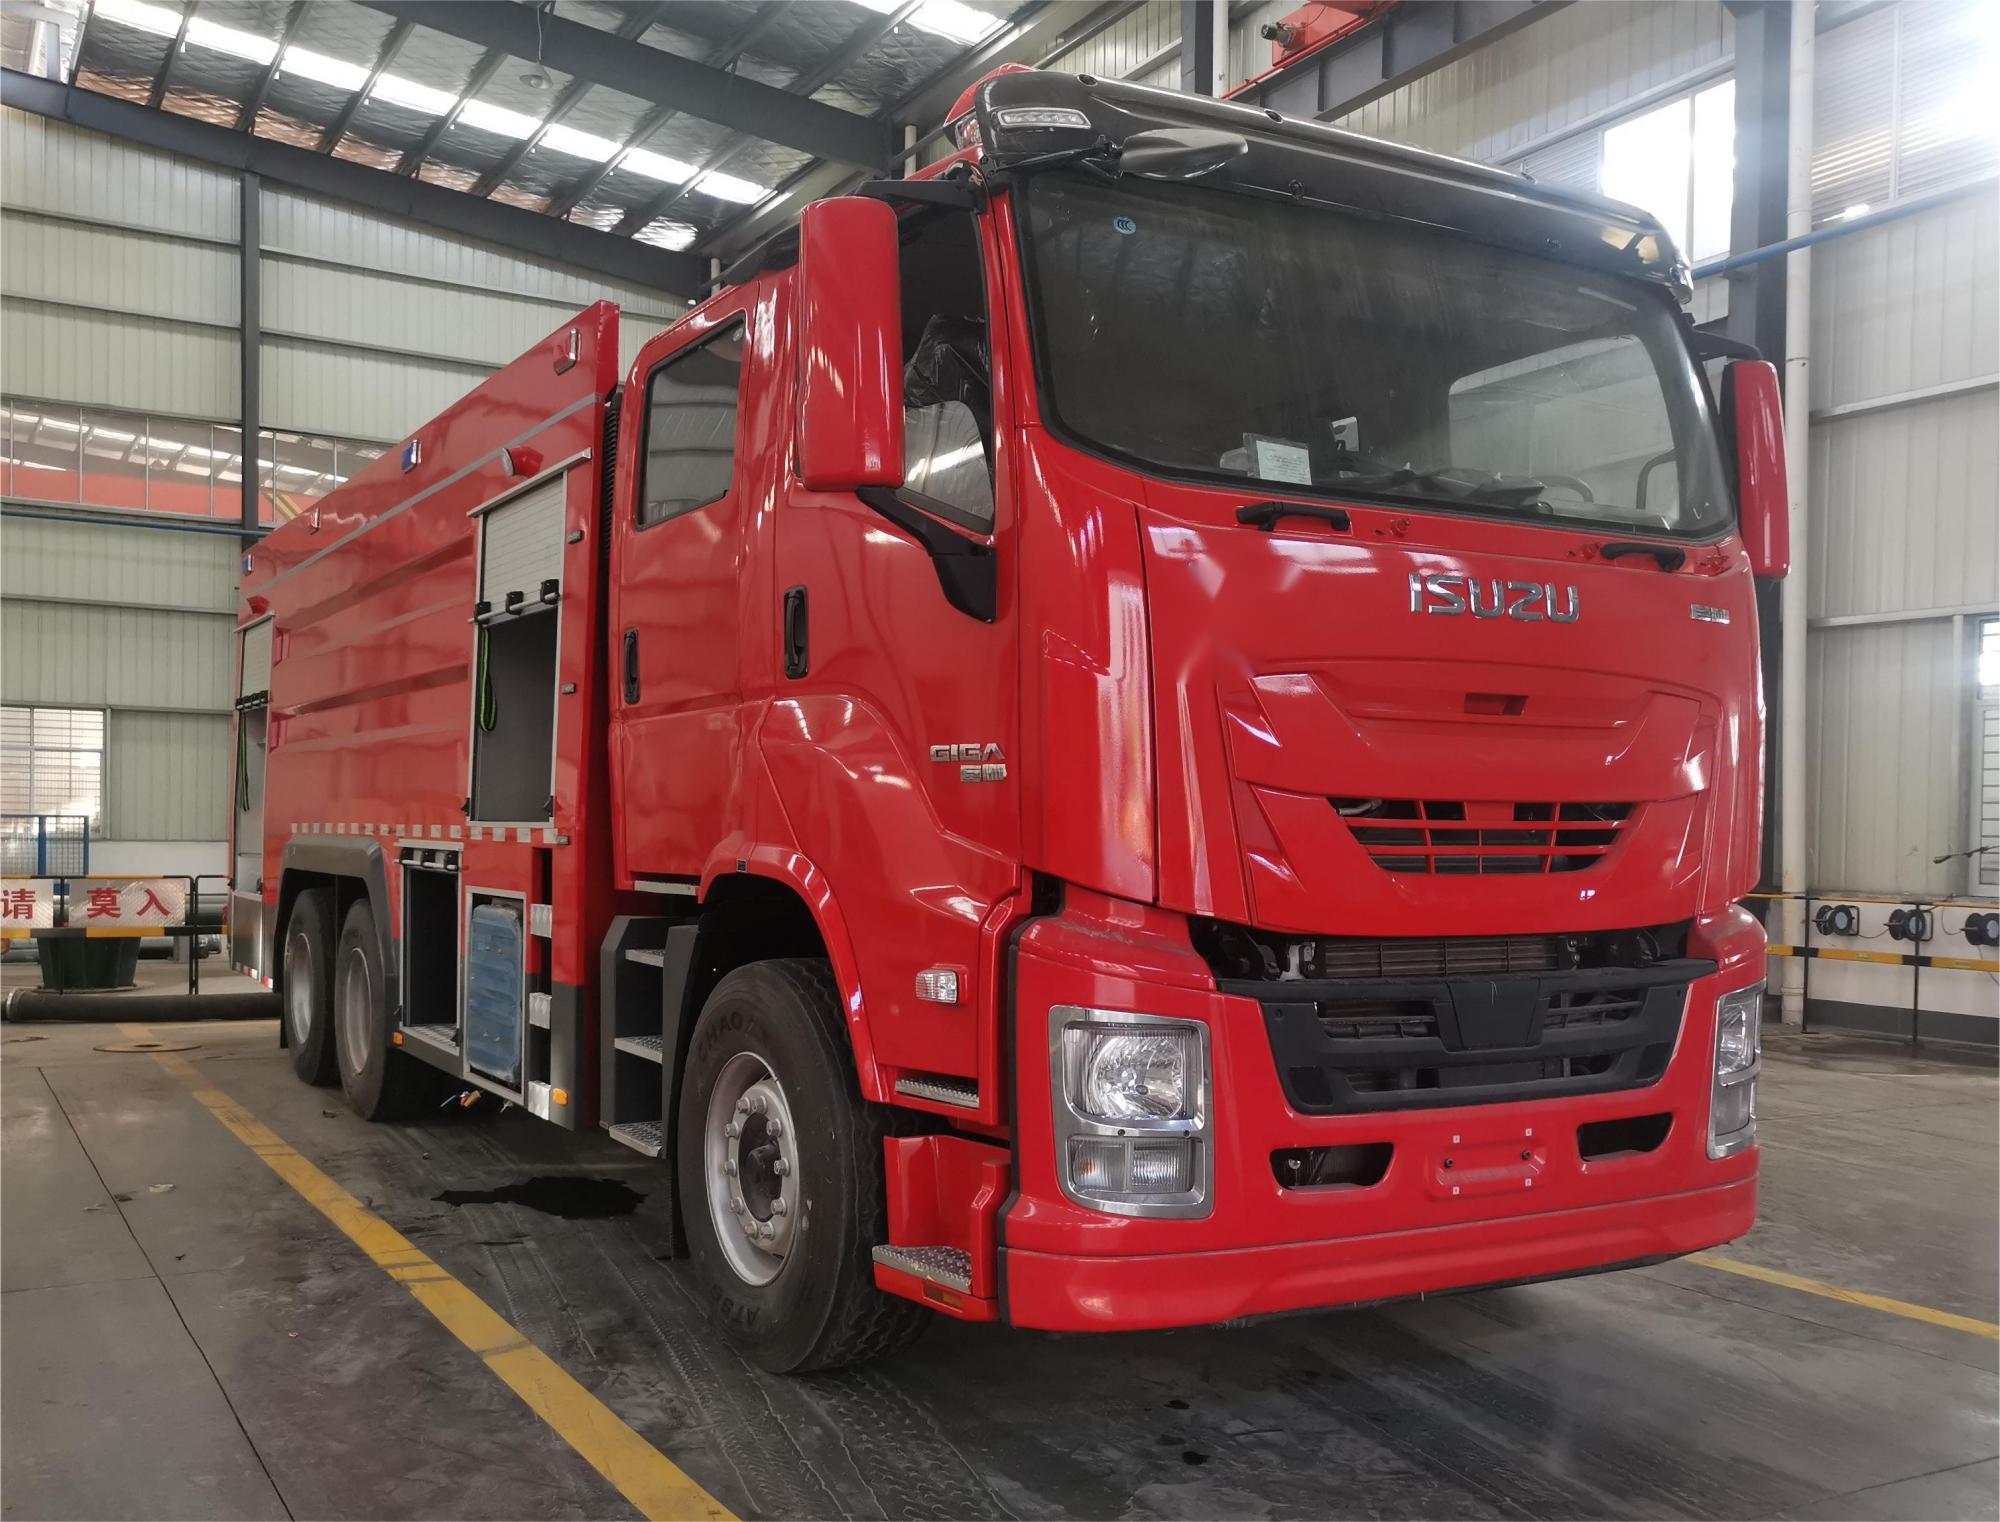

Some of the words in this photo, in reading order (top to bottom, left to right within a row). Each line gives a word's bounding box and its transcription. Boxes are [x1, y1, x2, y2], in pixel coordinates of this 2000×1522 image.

[1409, 572, 1580, 624] ISUZU
[930, 743, 1006, 762] GIGA
[1, 888, 37, 920] 请
[86, 887, 171, 920] 莫入
